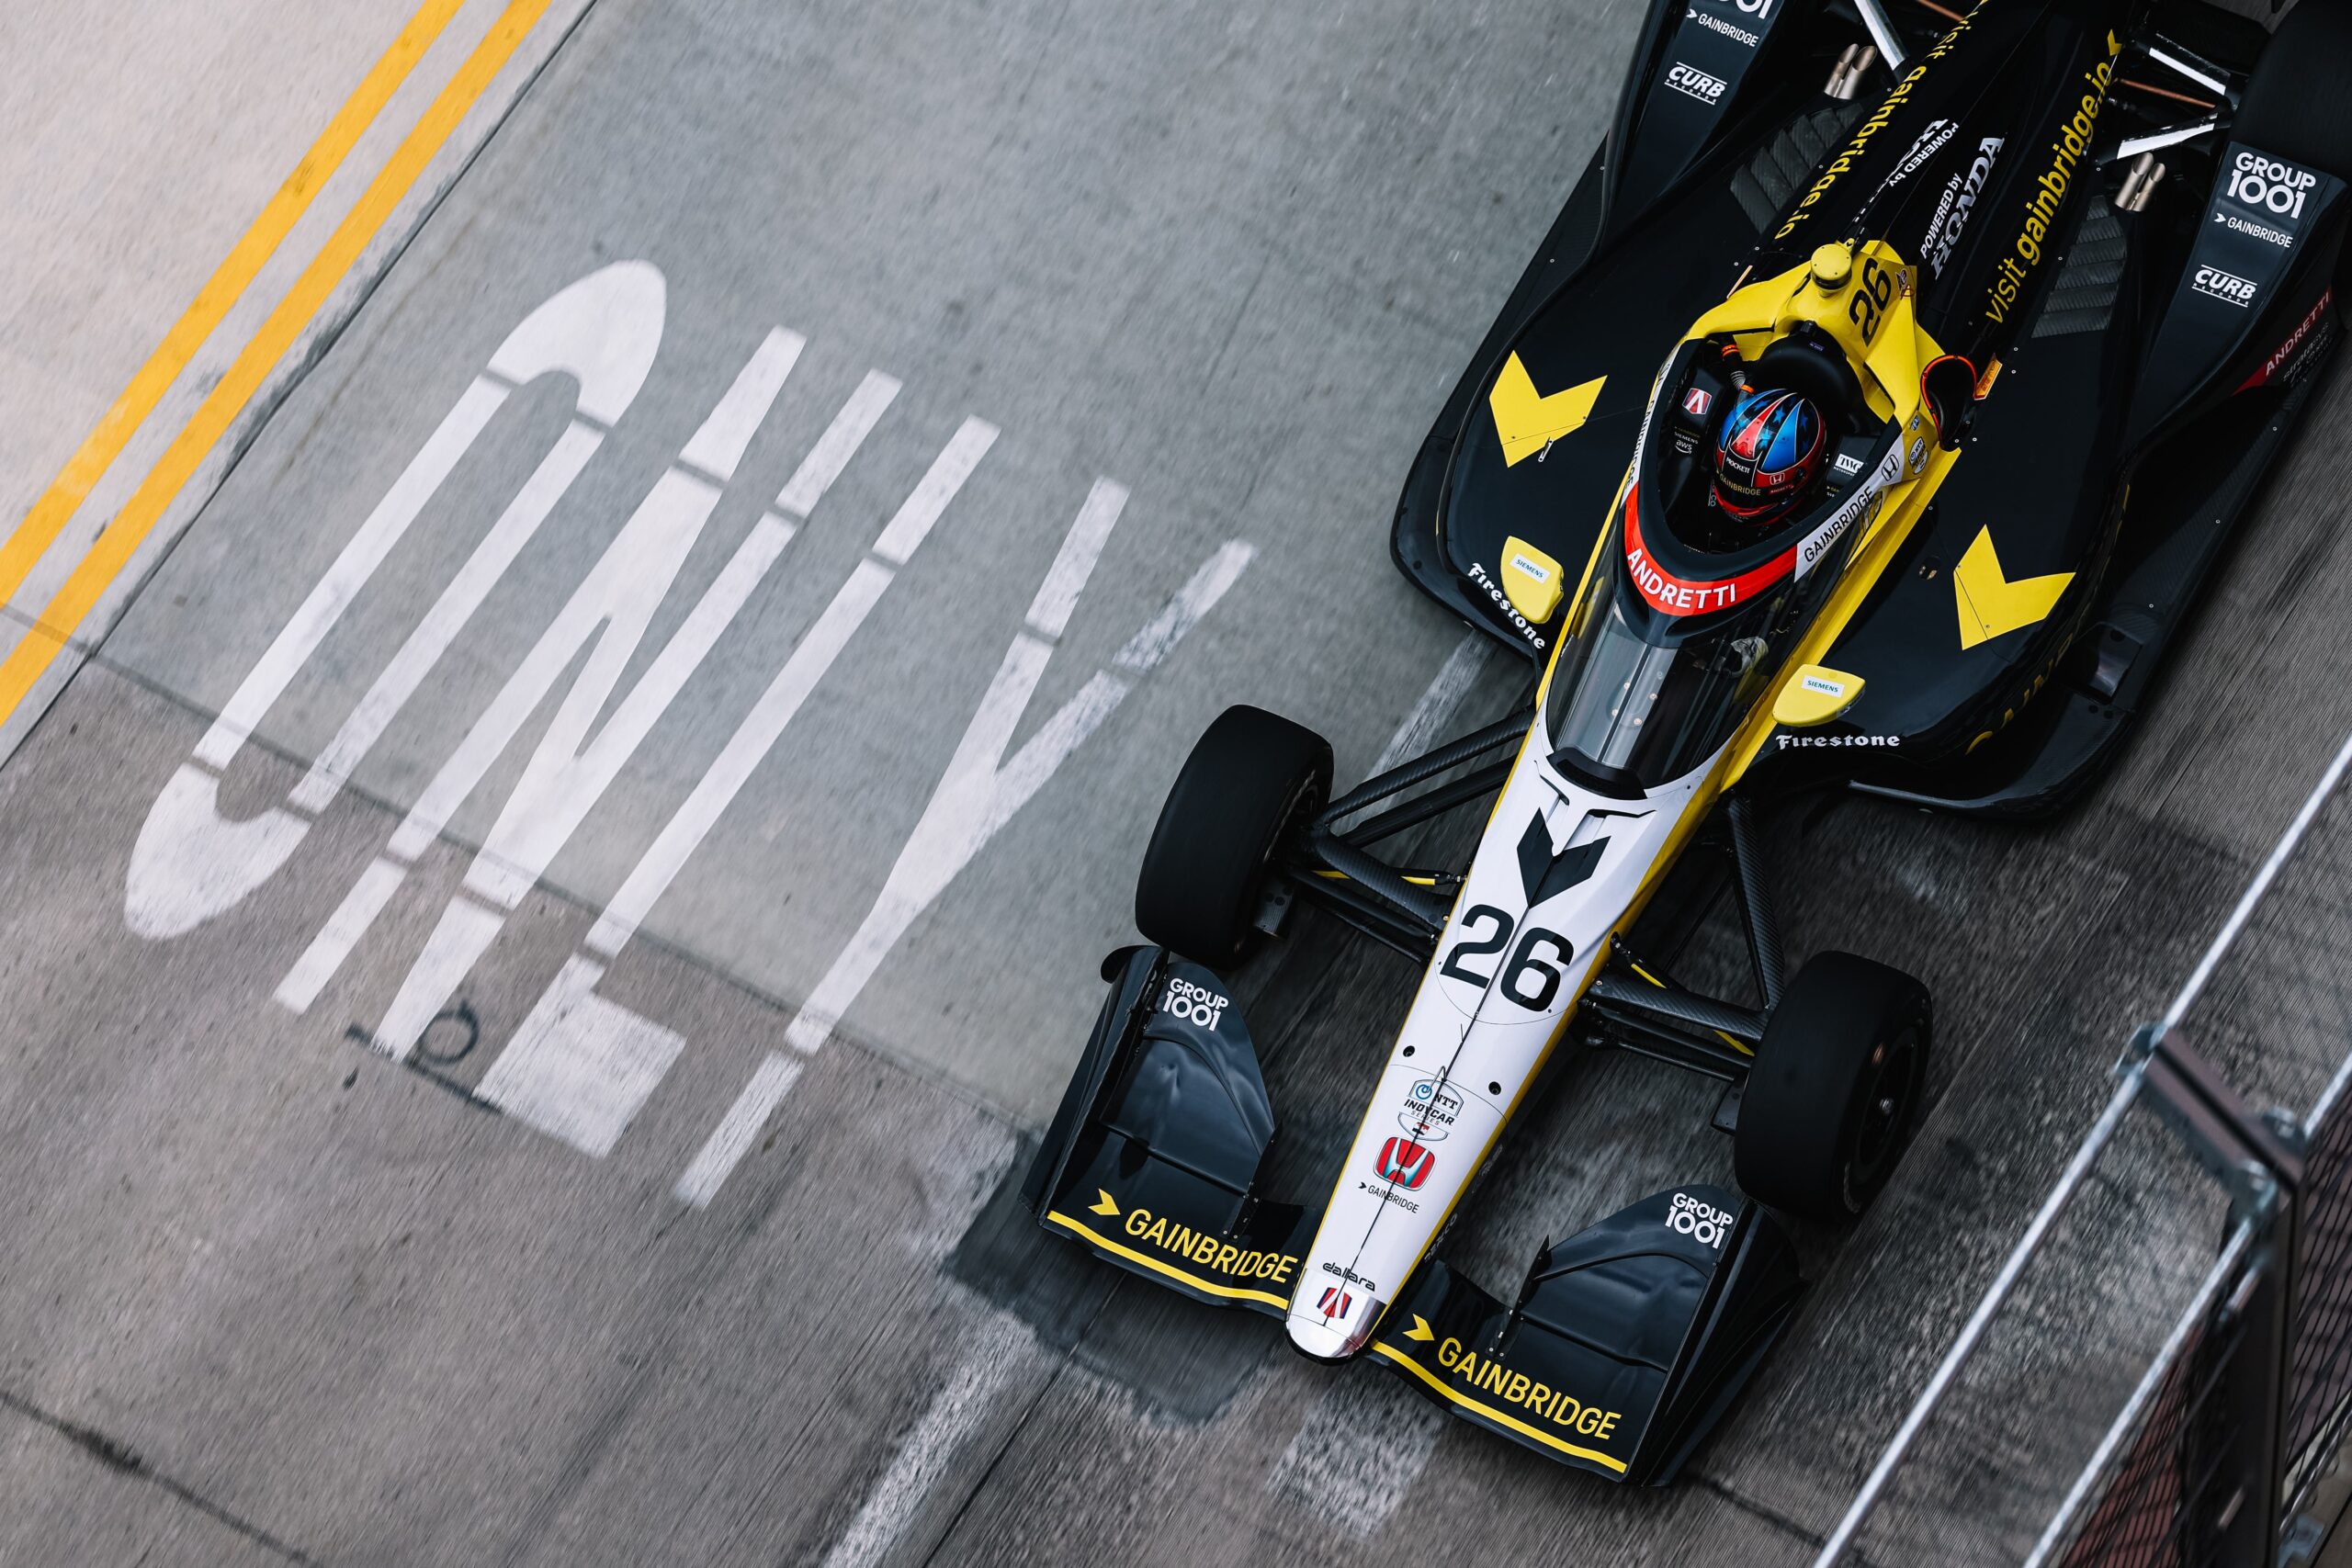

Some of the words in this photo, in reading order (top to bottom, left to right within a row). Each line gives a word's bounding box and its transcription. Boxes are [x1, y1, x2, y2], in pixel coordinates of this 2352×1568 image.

[1698, 13, 1759, 47] GAINBRIDGE
[1668, 66, 1726, 98] CURB
[2235, 152, 2316, 191] GROUP
[1930, 137, 2006, 280] HONDA
[1984, 256, 2027, 323] visit
[2017, 62, 2113, 266] gainbridge.io
[2226, 168, 2307, 220] 1001
[1919, 188, 1954, 260] POWERED
[1947, 173, 1963, 190] by
[2227, 217, 2293, 248] GAINBRIDGE
[1849, 257, 1892, 348] 26
[2195, 268, 2256, 299] CURB
[2266, 291, 2329, 377] ANDRETTI
[1676, 439, 1692, 450] aws
[1719, 473, 1761, 496] GAINBRIDGE
[1804, 485, 1873, 562] GAINBRIDGE
[1516, 558, 1544, 579] SIEMENS
[1627, 547, 1736, 609] ANDRETTI
[1467, 562, 1545, 649] Firestone
[1807, 680, 1838, 693] SIEMENS
[123, 257, 1258, 1212] ONLY
[1776, 734, 1900, 750] Firestone
[1439, 904, 1575, 1012] 26
[1162, 990, 1222, 1032] 1001
[1170, 977, 1229, 1010] GROUP
[1404, 1099, 1455, 1126] INDYCAR
[1433, 1093, 1458, 1110] NTT
[1367, 1184, 1420, 1214] GAINBRIDGE
[1672, 1191, 1734, 1229] GROUP
[1124, 1208, 1299, 1284] GAINBRIDGE
[1664, 1205, 1727, 1250] 1001
[1322, 1261, 1376, 1292] dallara
[1437, 1337, 1623, 1441] GAINBRIDGE
